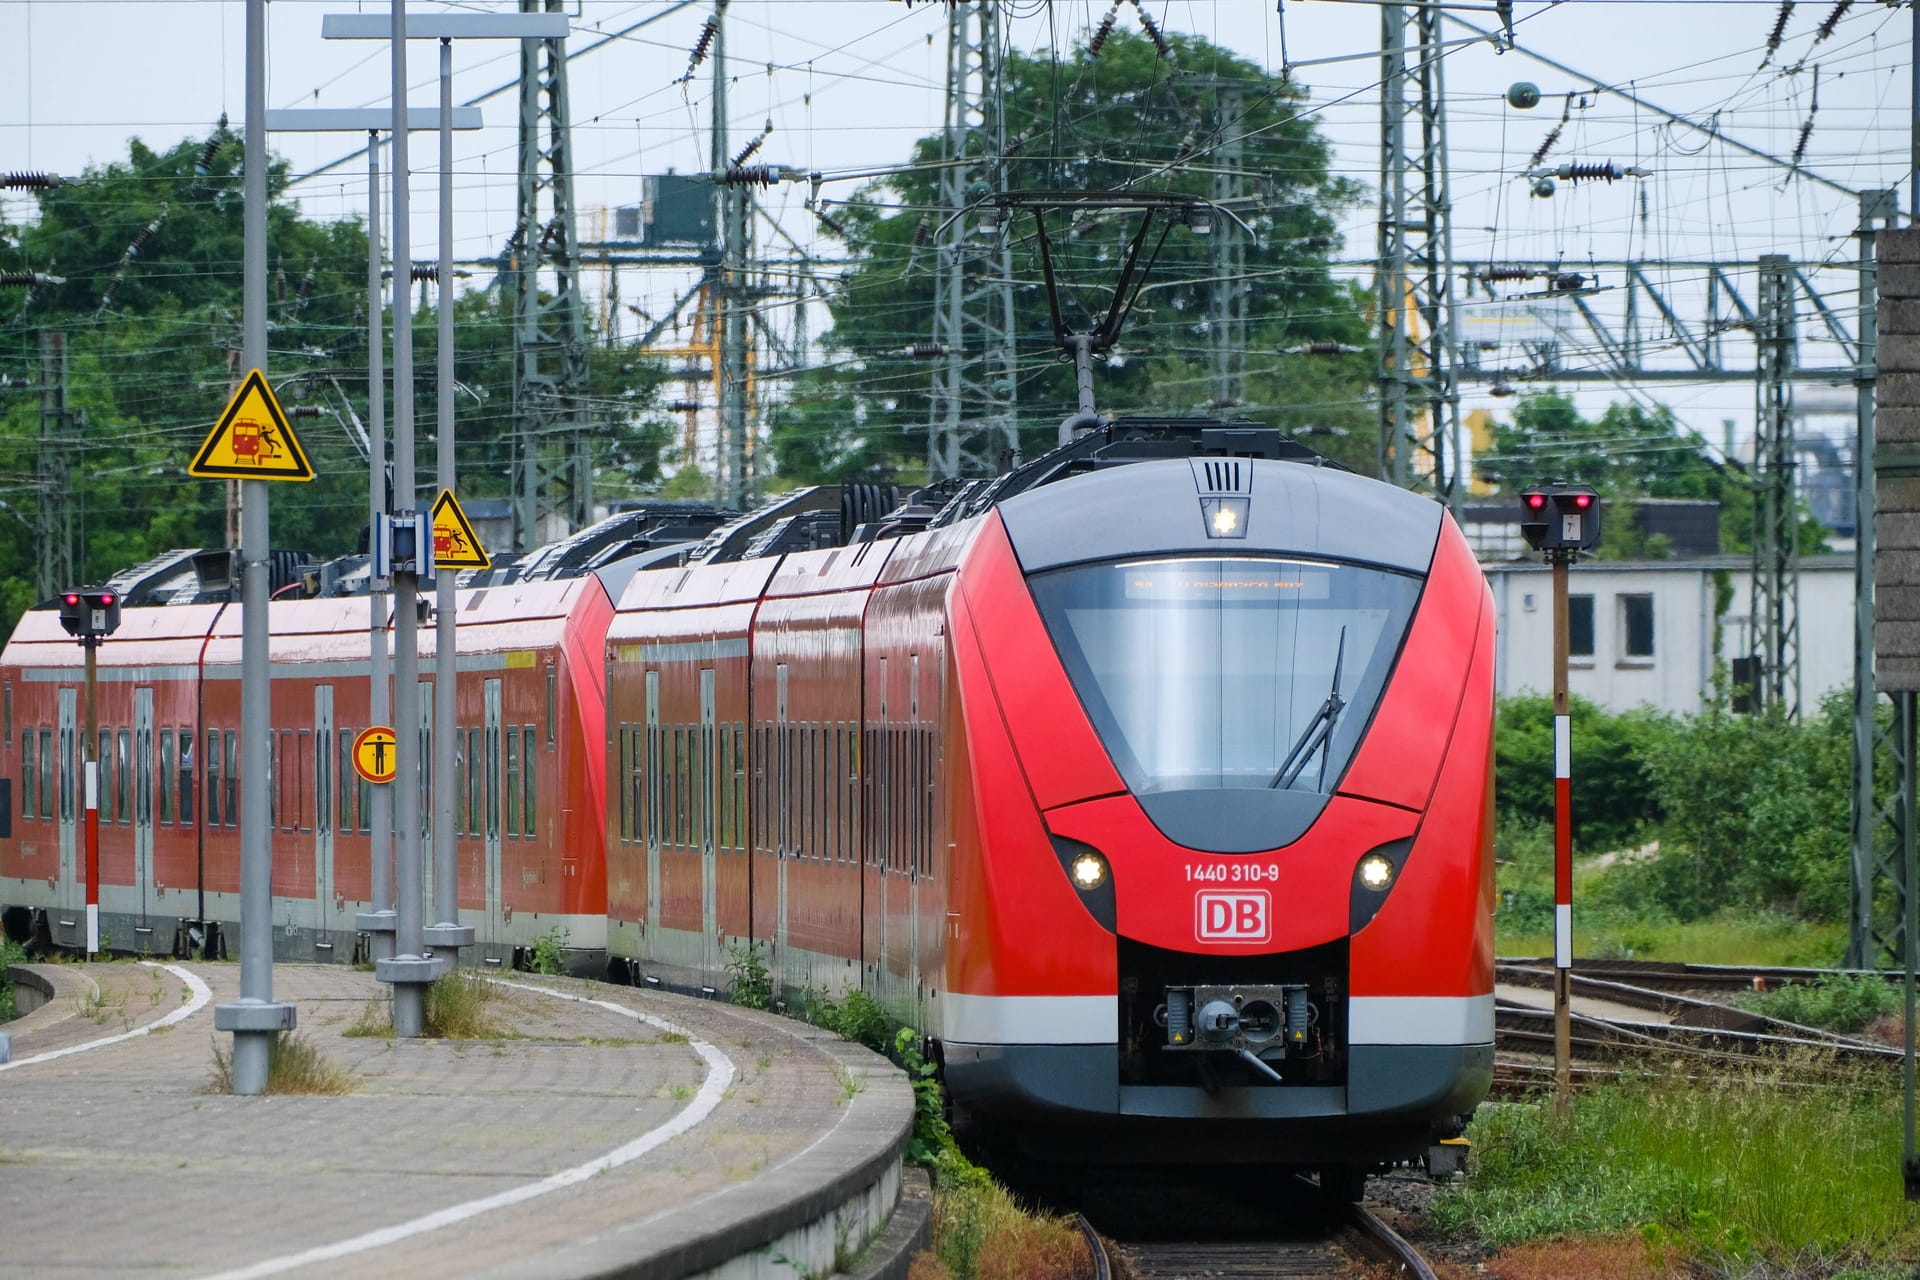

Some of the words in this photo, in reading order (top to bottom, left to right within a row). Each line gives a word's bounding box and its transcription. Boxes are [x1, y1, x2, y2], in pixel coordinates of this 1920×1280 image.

[1185, 864, 1227, 882] 1440
[1231, 864, 1279, 882] 310-9
[1206, 899, 1262, 934] DB
